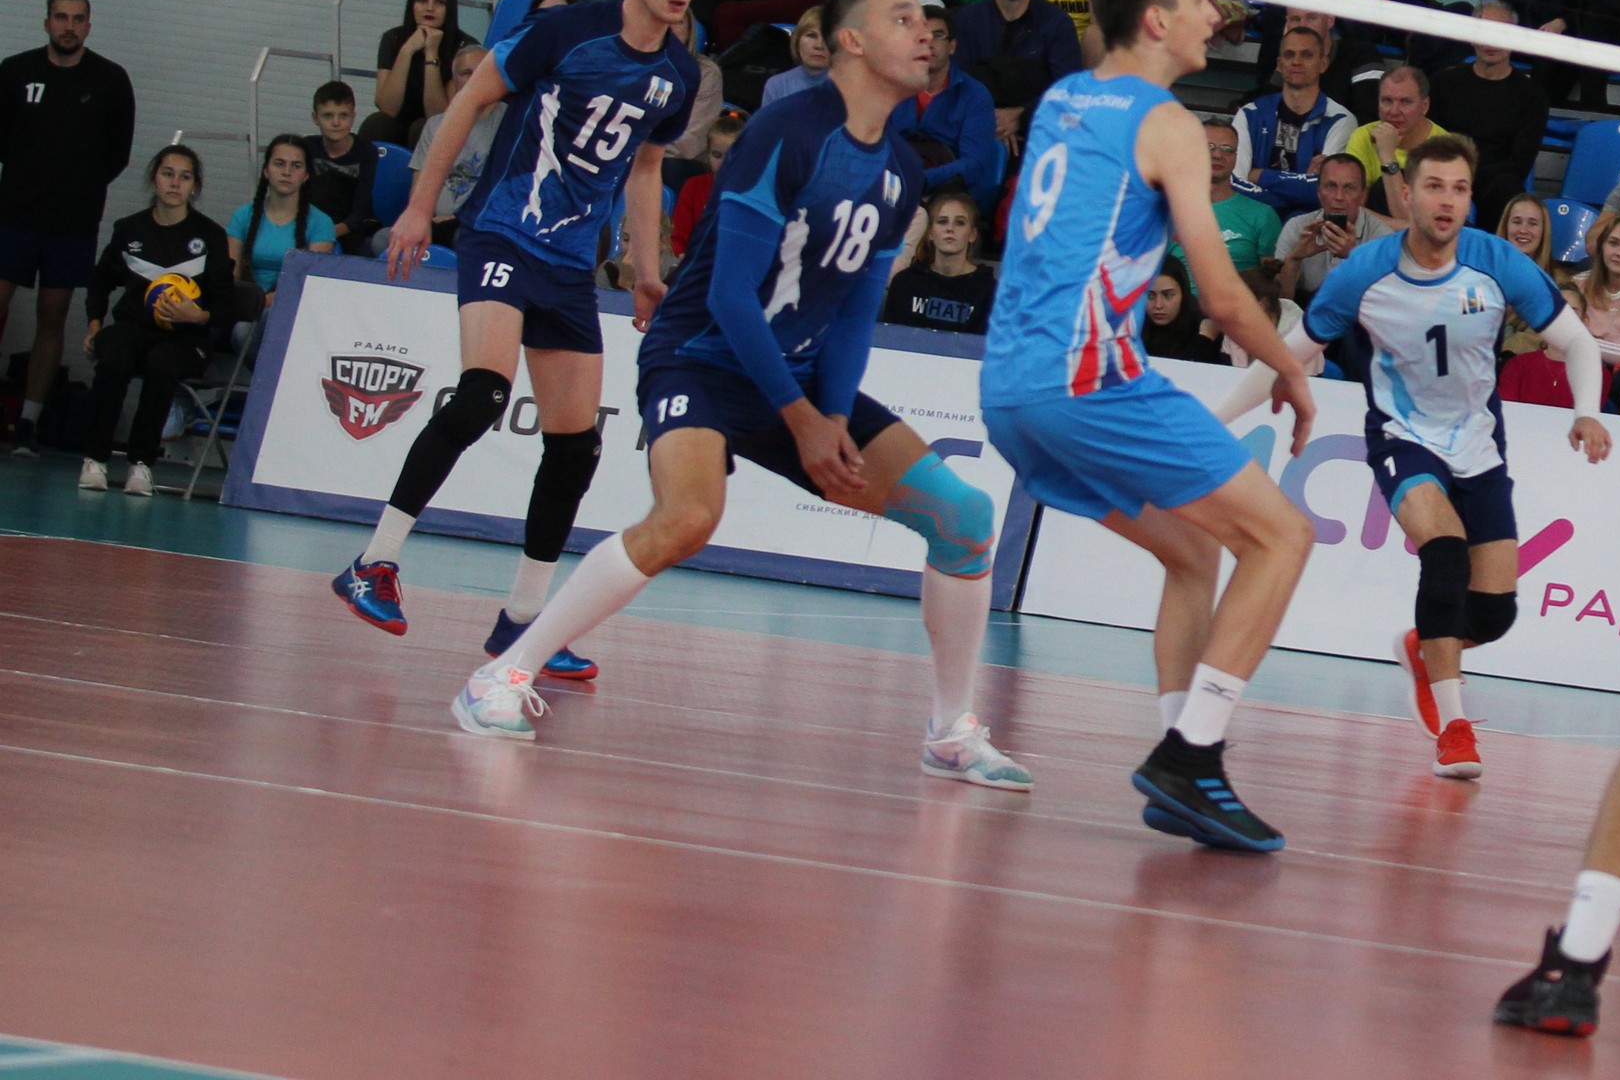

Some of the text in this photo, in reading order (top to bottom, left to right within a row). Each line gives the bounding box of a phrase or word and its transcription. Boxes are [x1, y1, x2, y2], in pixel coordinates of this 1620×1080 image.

[25, 82, 46, 103] 17
[572, 94, 646, 162] 15
[1022, 142, 1068, 243] 9
[820, 199, 880, 273] 18
[480, 261, 514, 288] 15
[354, 341, 408, 355] РАДИО
[1425, 324, 1449, 377] 1
[334, 359, 417, 392] СПОРТ
[348, 397, 390, 428] FM
[657, 394, 690, 424] 18
[910, 407, 975, 423] КОМПАНИЯ
[1384, 456, 1397, 477] 1
